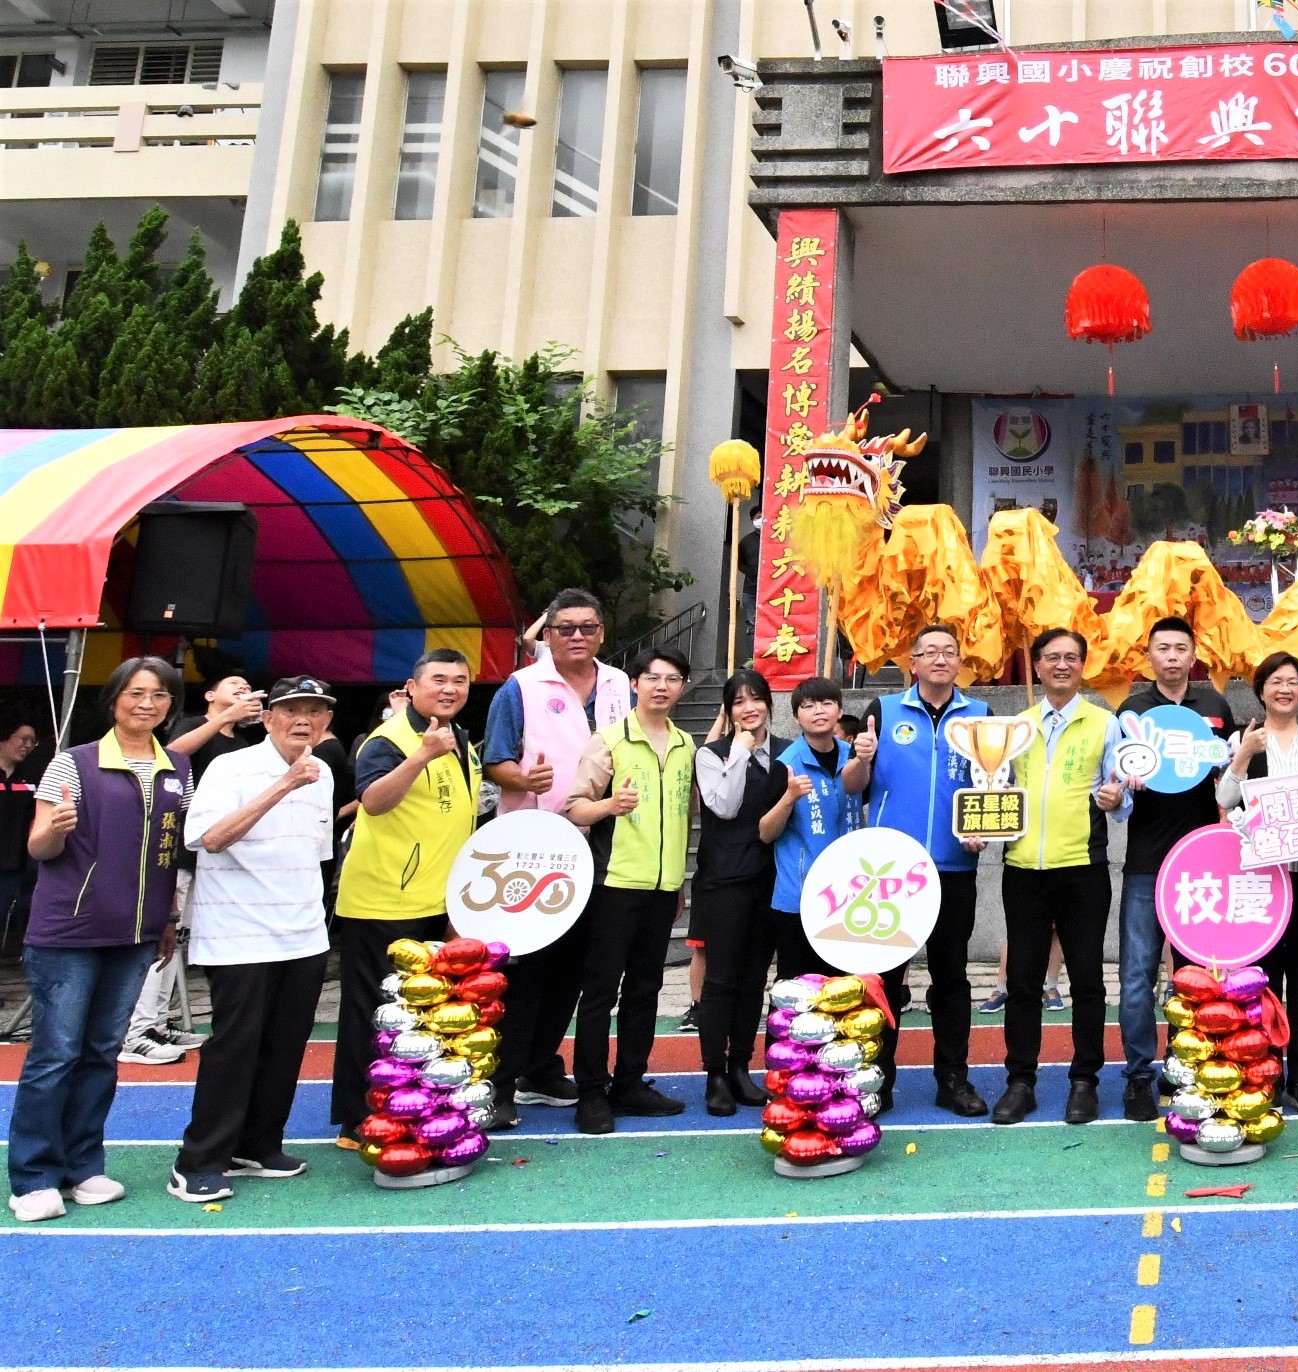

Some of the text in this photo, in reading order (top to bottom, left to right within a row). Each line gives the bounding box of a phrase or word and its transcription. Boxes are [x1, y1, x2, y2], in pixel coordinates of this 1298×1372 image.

[963, 794, 1020, 812] 五星級
[963, 813, 1020, 831] 旗艦獎
[1174, 871, 1274, 926] 校慶
